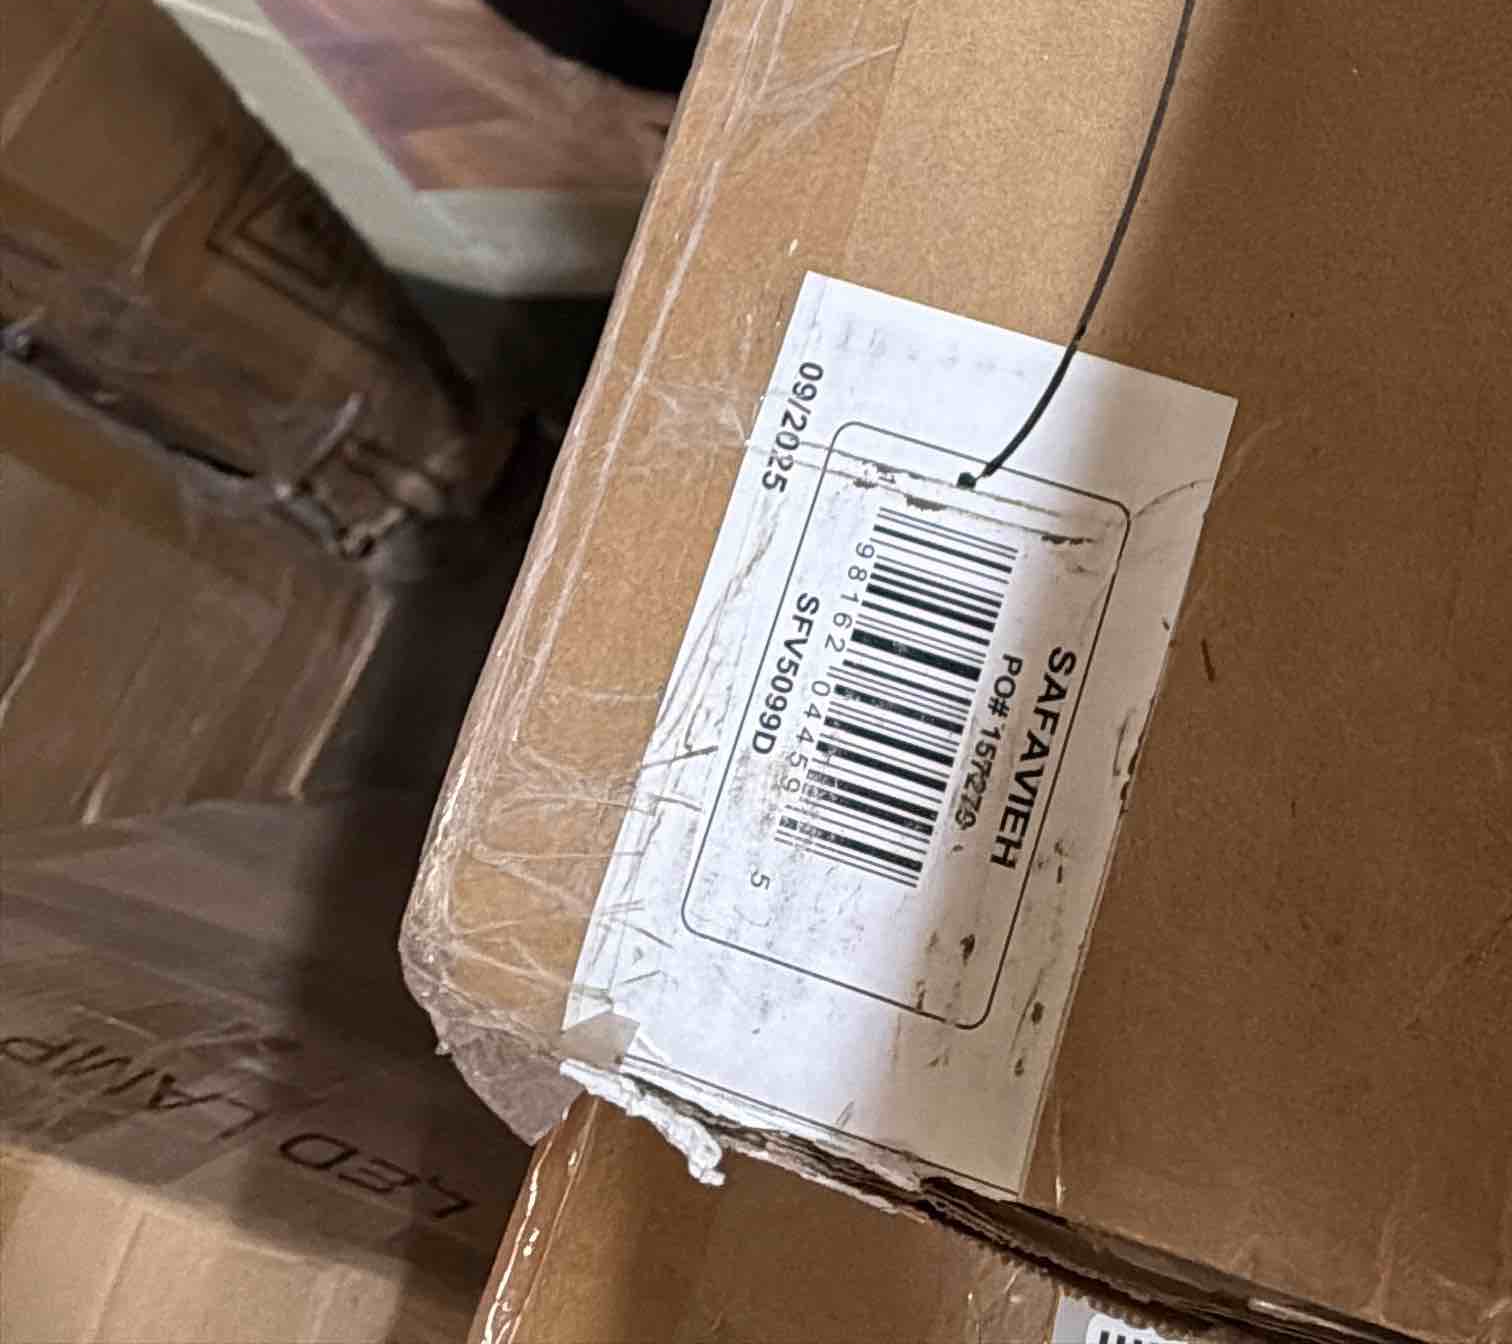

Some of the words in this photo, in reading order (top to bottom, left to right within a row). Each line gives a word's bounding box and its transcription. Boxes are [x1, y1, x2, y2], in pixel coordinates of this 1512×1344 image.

[762, 360, 823, 493] 09/2025
[825, 541, 876, 656] 98162
[751, 592, 819, 756] SFV5099D
[985, 652, 1025, 718] PO#
[780, 679, 832, 795] 04459
[989, 646, 1078, 869] SAFAVIEH
[746, 870, 771, 891] 5
[0, 1036, 270, 1140] LAMP
[279, 1132, 474, 1219] LED
